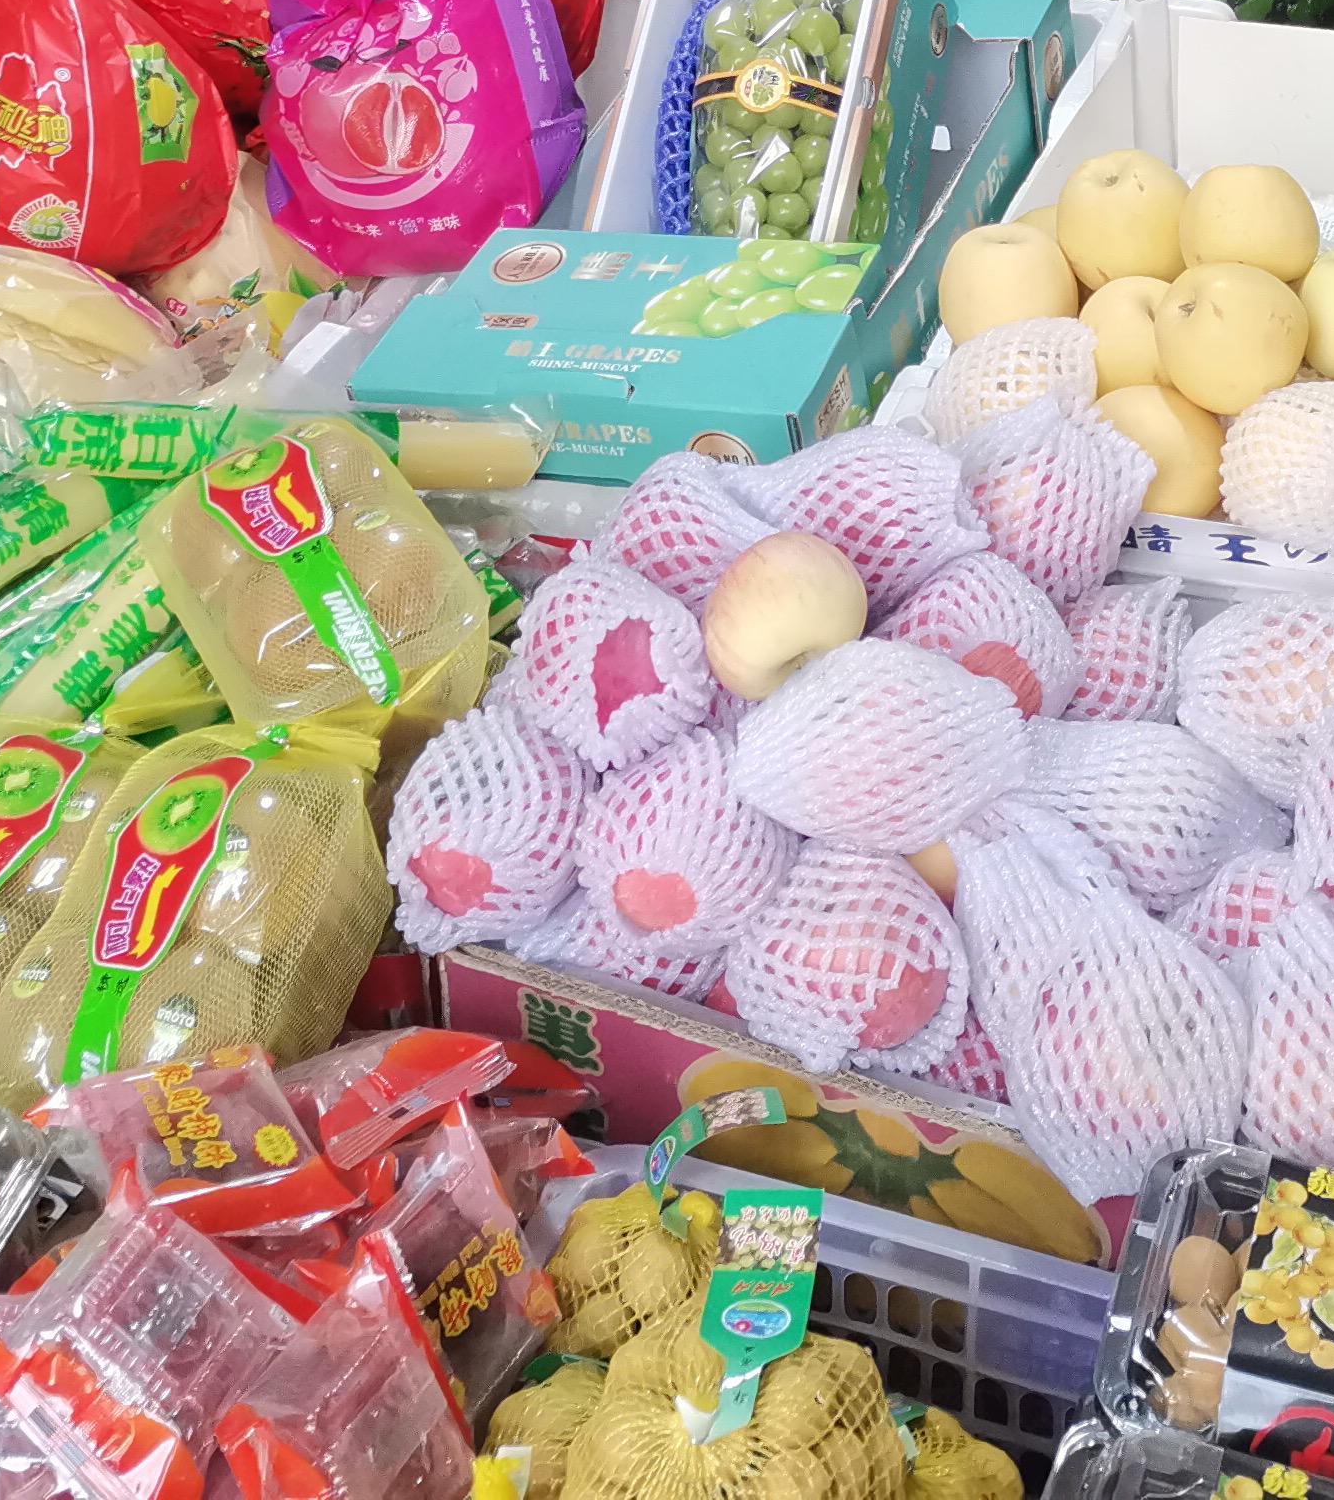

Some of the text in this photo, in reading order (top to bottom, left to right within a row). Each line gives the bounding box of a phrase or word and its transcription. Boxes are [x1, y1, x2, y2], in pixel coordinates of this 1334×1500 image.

[565, 344, 682, 364] GRAPES
[527, 358, 643, 374] SHINE-MUSCAT
[322, 589, 365, 641] KIWI
